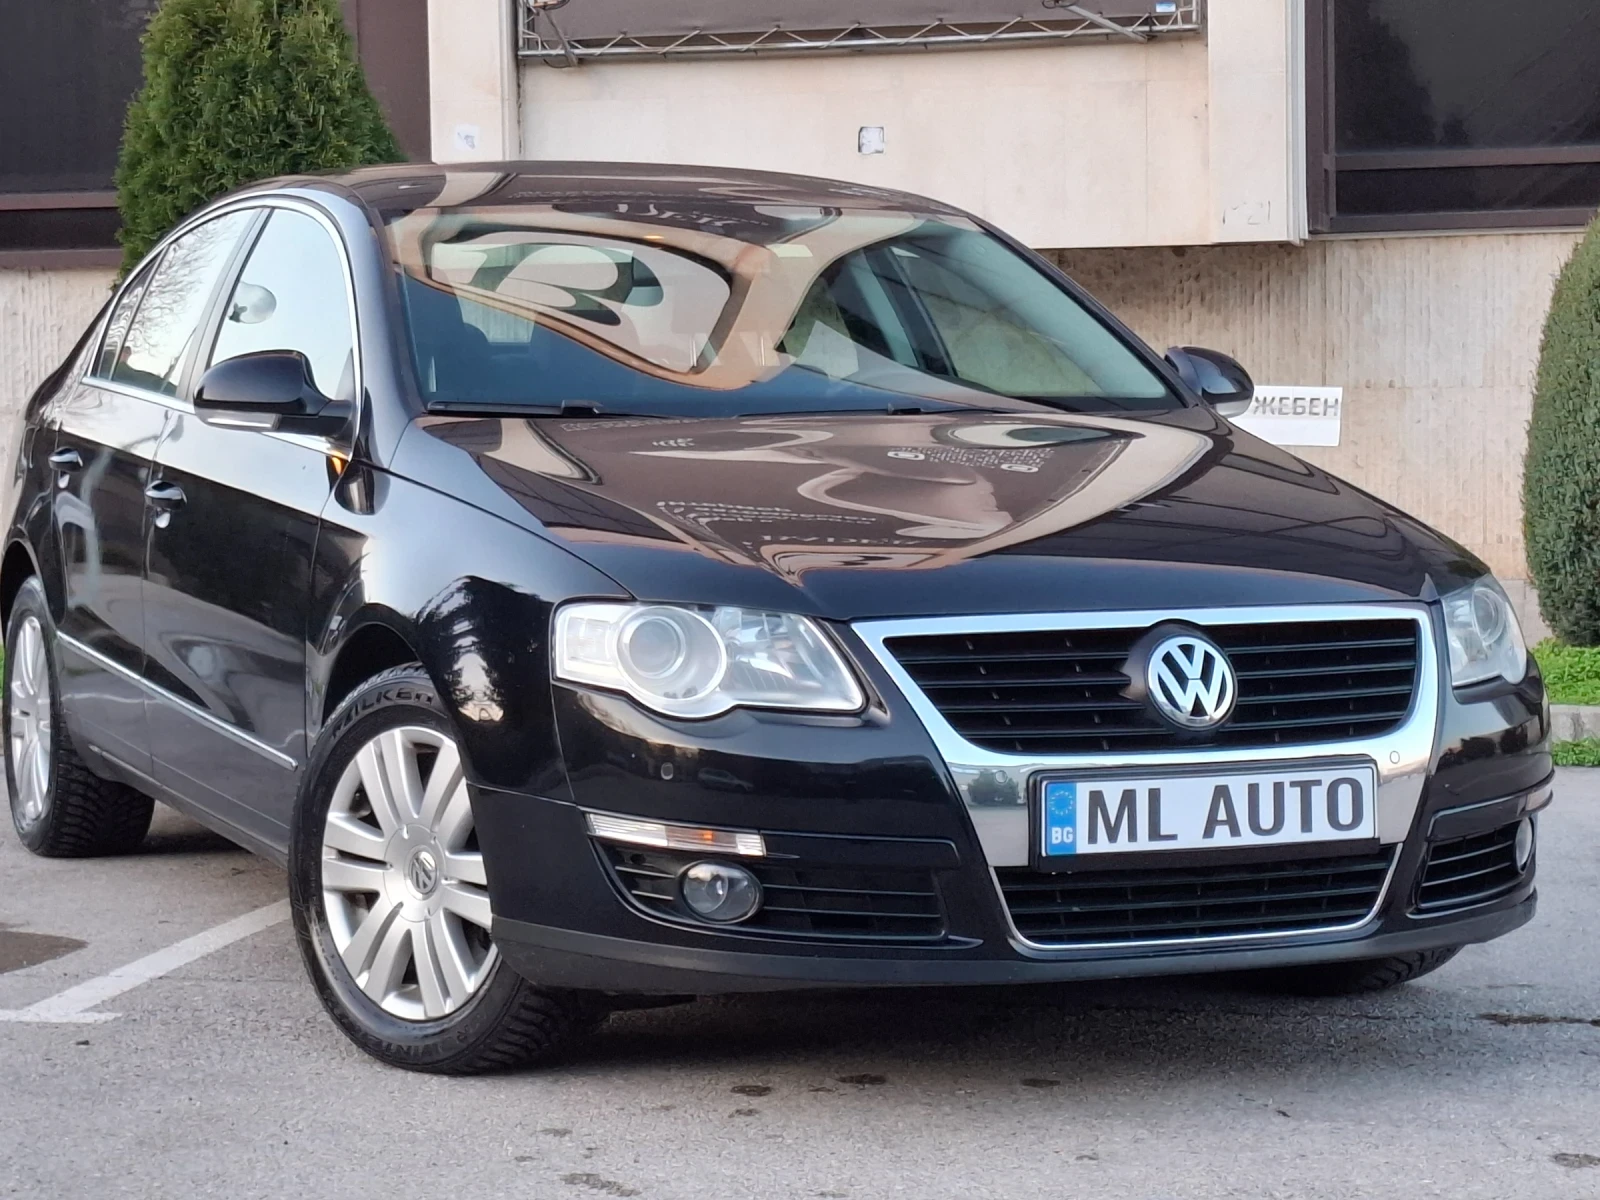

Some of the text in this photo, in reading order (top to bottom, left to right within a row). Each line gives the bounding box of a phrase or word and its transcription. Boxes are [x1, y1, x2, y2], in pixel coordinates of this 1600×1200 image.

[1253, 395, 1339, 416] ЖЕБЕН
[1087, 777, 1364, 845] ML AUTO
[1051, 826, 1074, 845] BG
